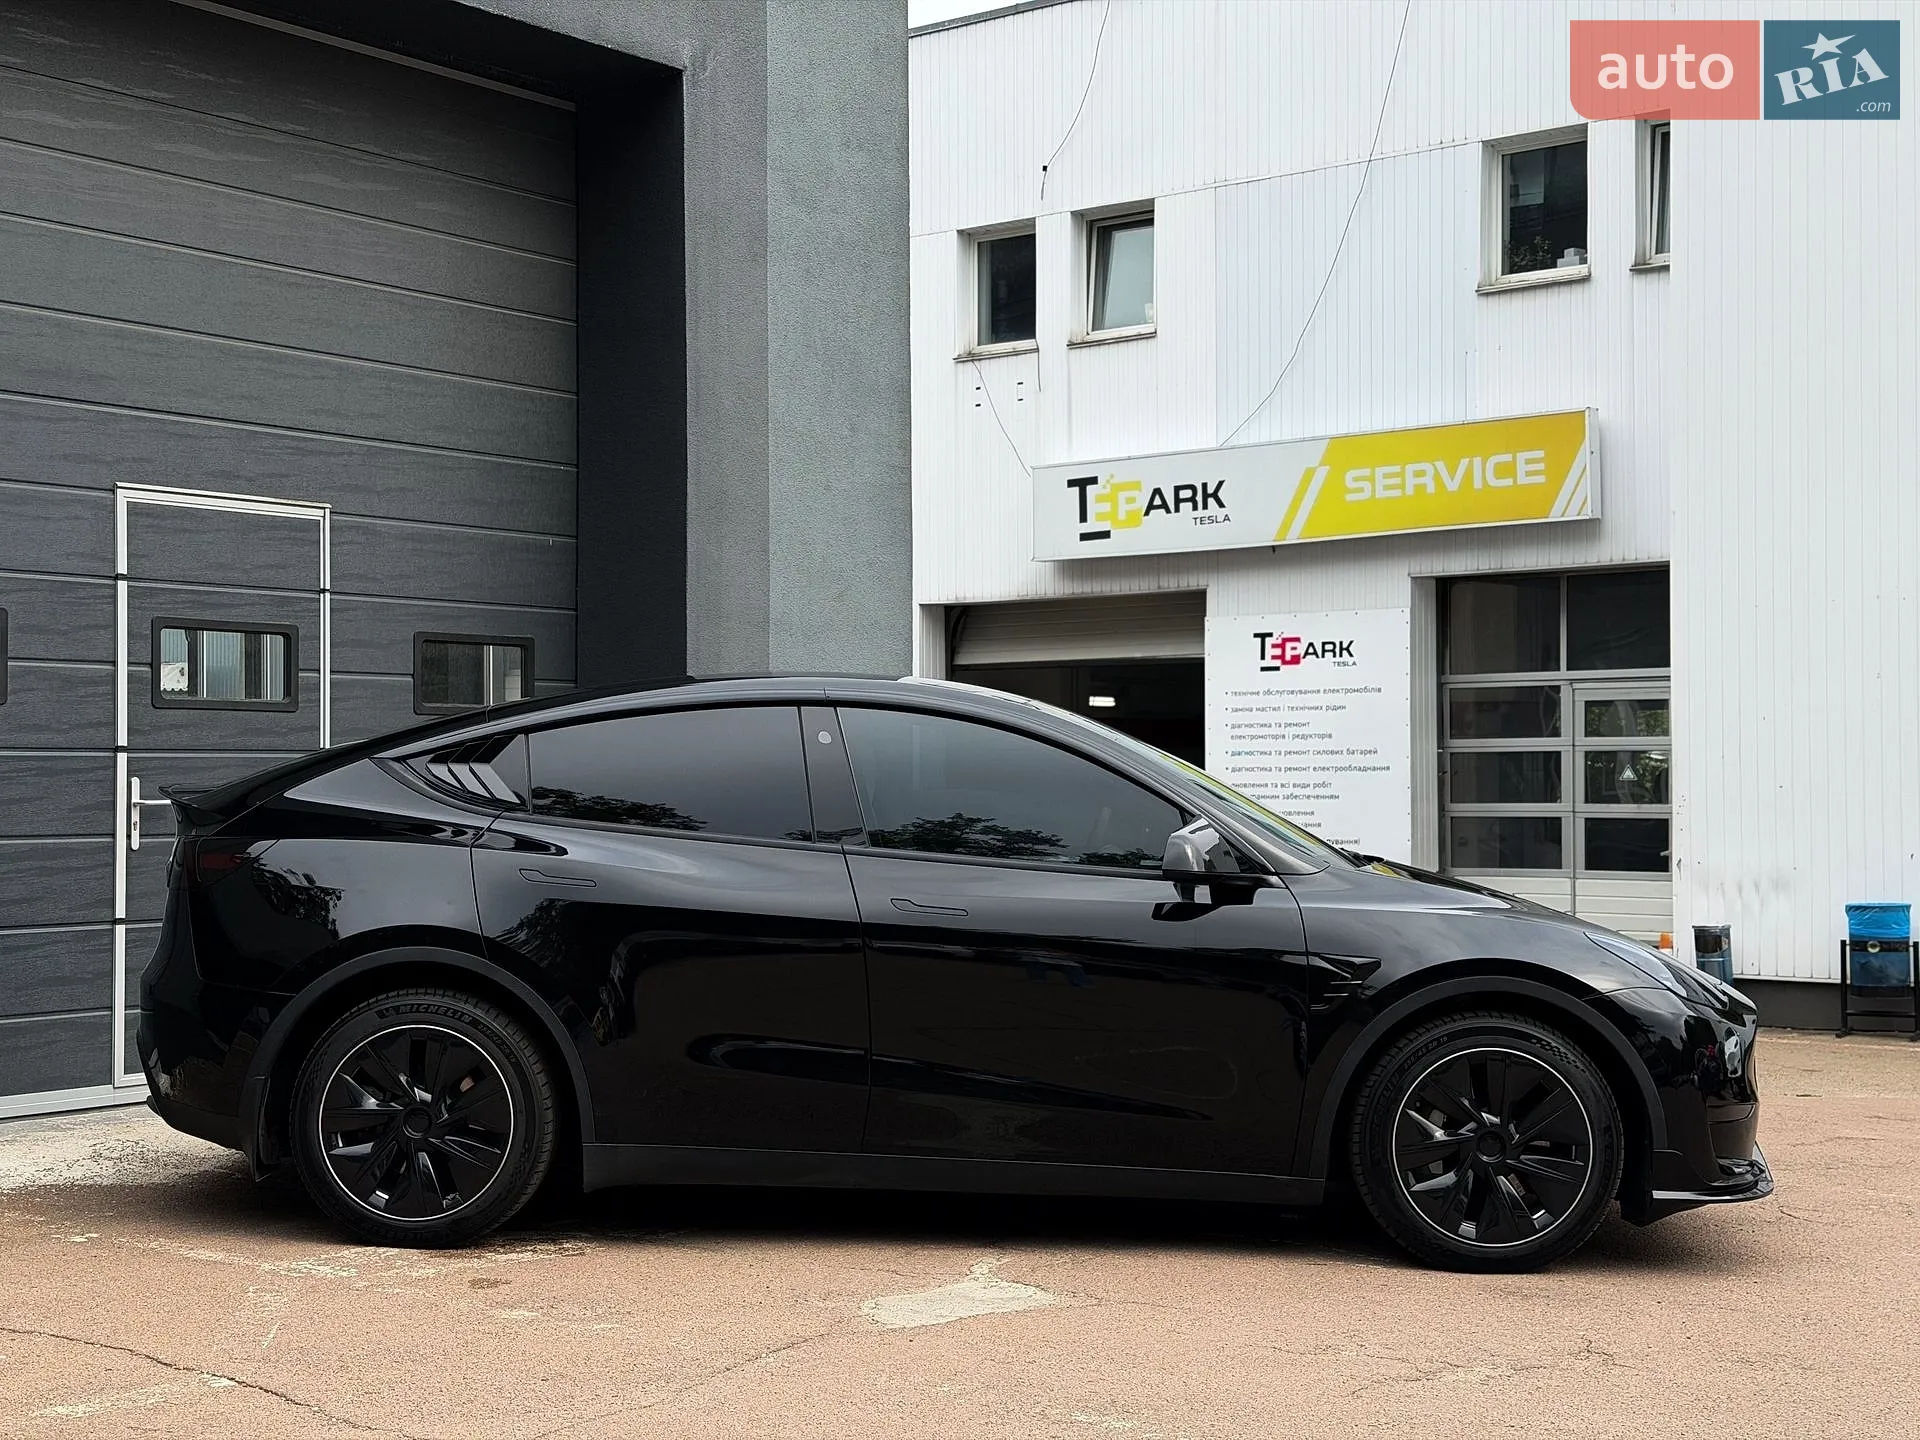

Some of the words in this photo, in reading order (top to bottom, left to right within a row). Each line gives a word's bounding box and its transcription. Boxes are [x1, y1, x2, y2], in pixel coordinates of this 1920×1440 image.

[1345, 450, 1546, 502] SERVICE
[1192, 514, 1231, 526] TESLA
[1262, 688, 1320, 697] обслуговування
[1323, 686, 1382, 696] електромобілів
[1325, 704, 1346, 712] рідин
[1230, 722, 1272, 730] діагностика
[1284, 721, 1310, 730] ремонт
[1230, 732, 1286, 741] електромоторів
[1291, 731, 1332, 741] редукторів
[1230, 749, 1272, 758] діагностика
[1284, 749, 1310, 757] ремонт
[1312, 748, 1344, 756] силових
[1346, 747, 1378, 756] батарей
[1230, 765, 1272, 774] діагностика
[1284, 765, 1310, 774] ремонт
[1312, 764, 1391, 773] електрообладнання
[1280, 781, 1290, 789] всі
[1312, 781, 1332, 790] робіт
[397, 1002, 474, 1023] MICHELIN
